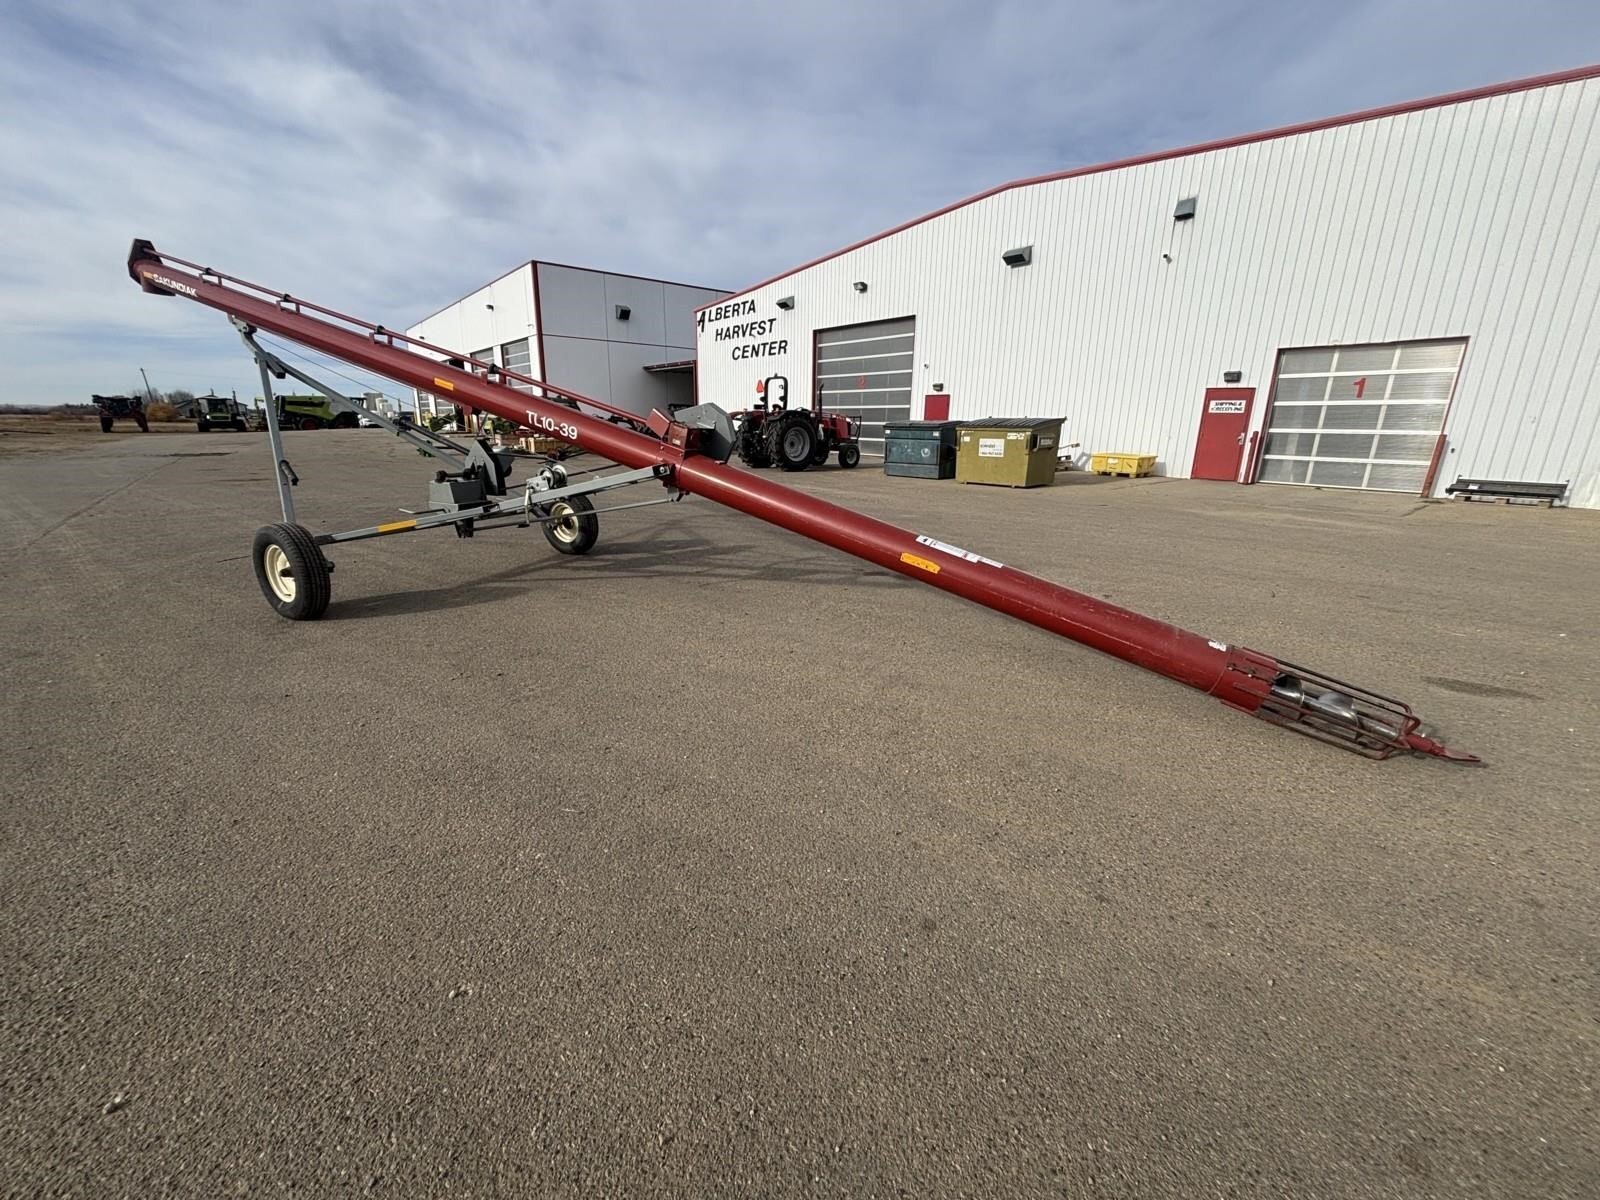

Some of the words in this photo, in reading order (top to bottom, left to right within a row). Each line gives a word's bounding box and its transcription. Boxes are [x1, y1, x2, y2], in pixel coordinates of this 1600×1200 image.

[153, 273, 199, 297] SAKUNDIAK
[697, 299, 756, 333] ALBERTA
[715, 318, 777, 342] HARVEST
[732, 340, 788, 361] CENTER
[1352, 377, 1367, 399] 1
[525, 410, 578, 440] TL10-39
